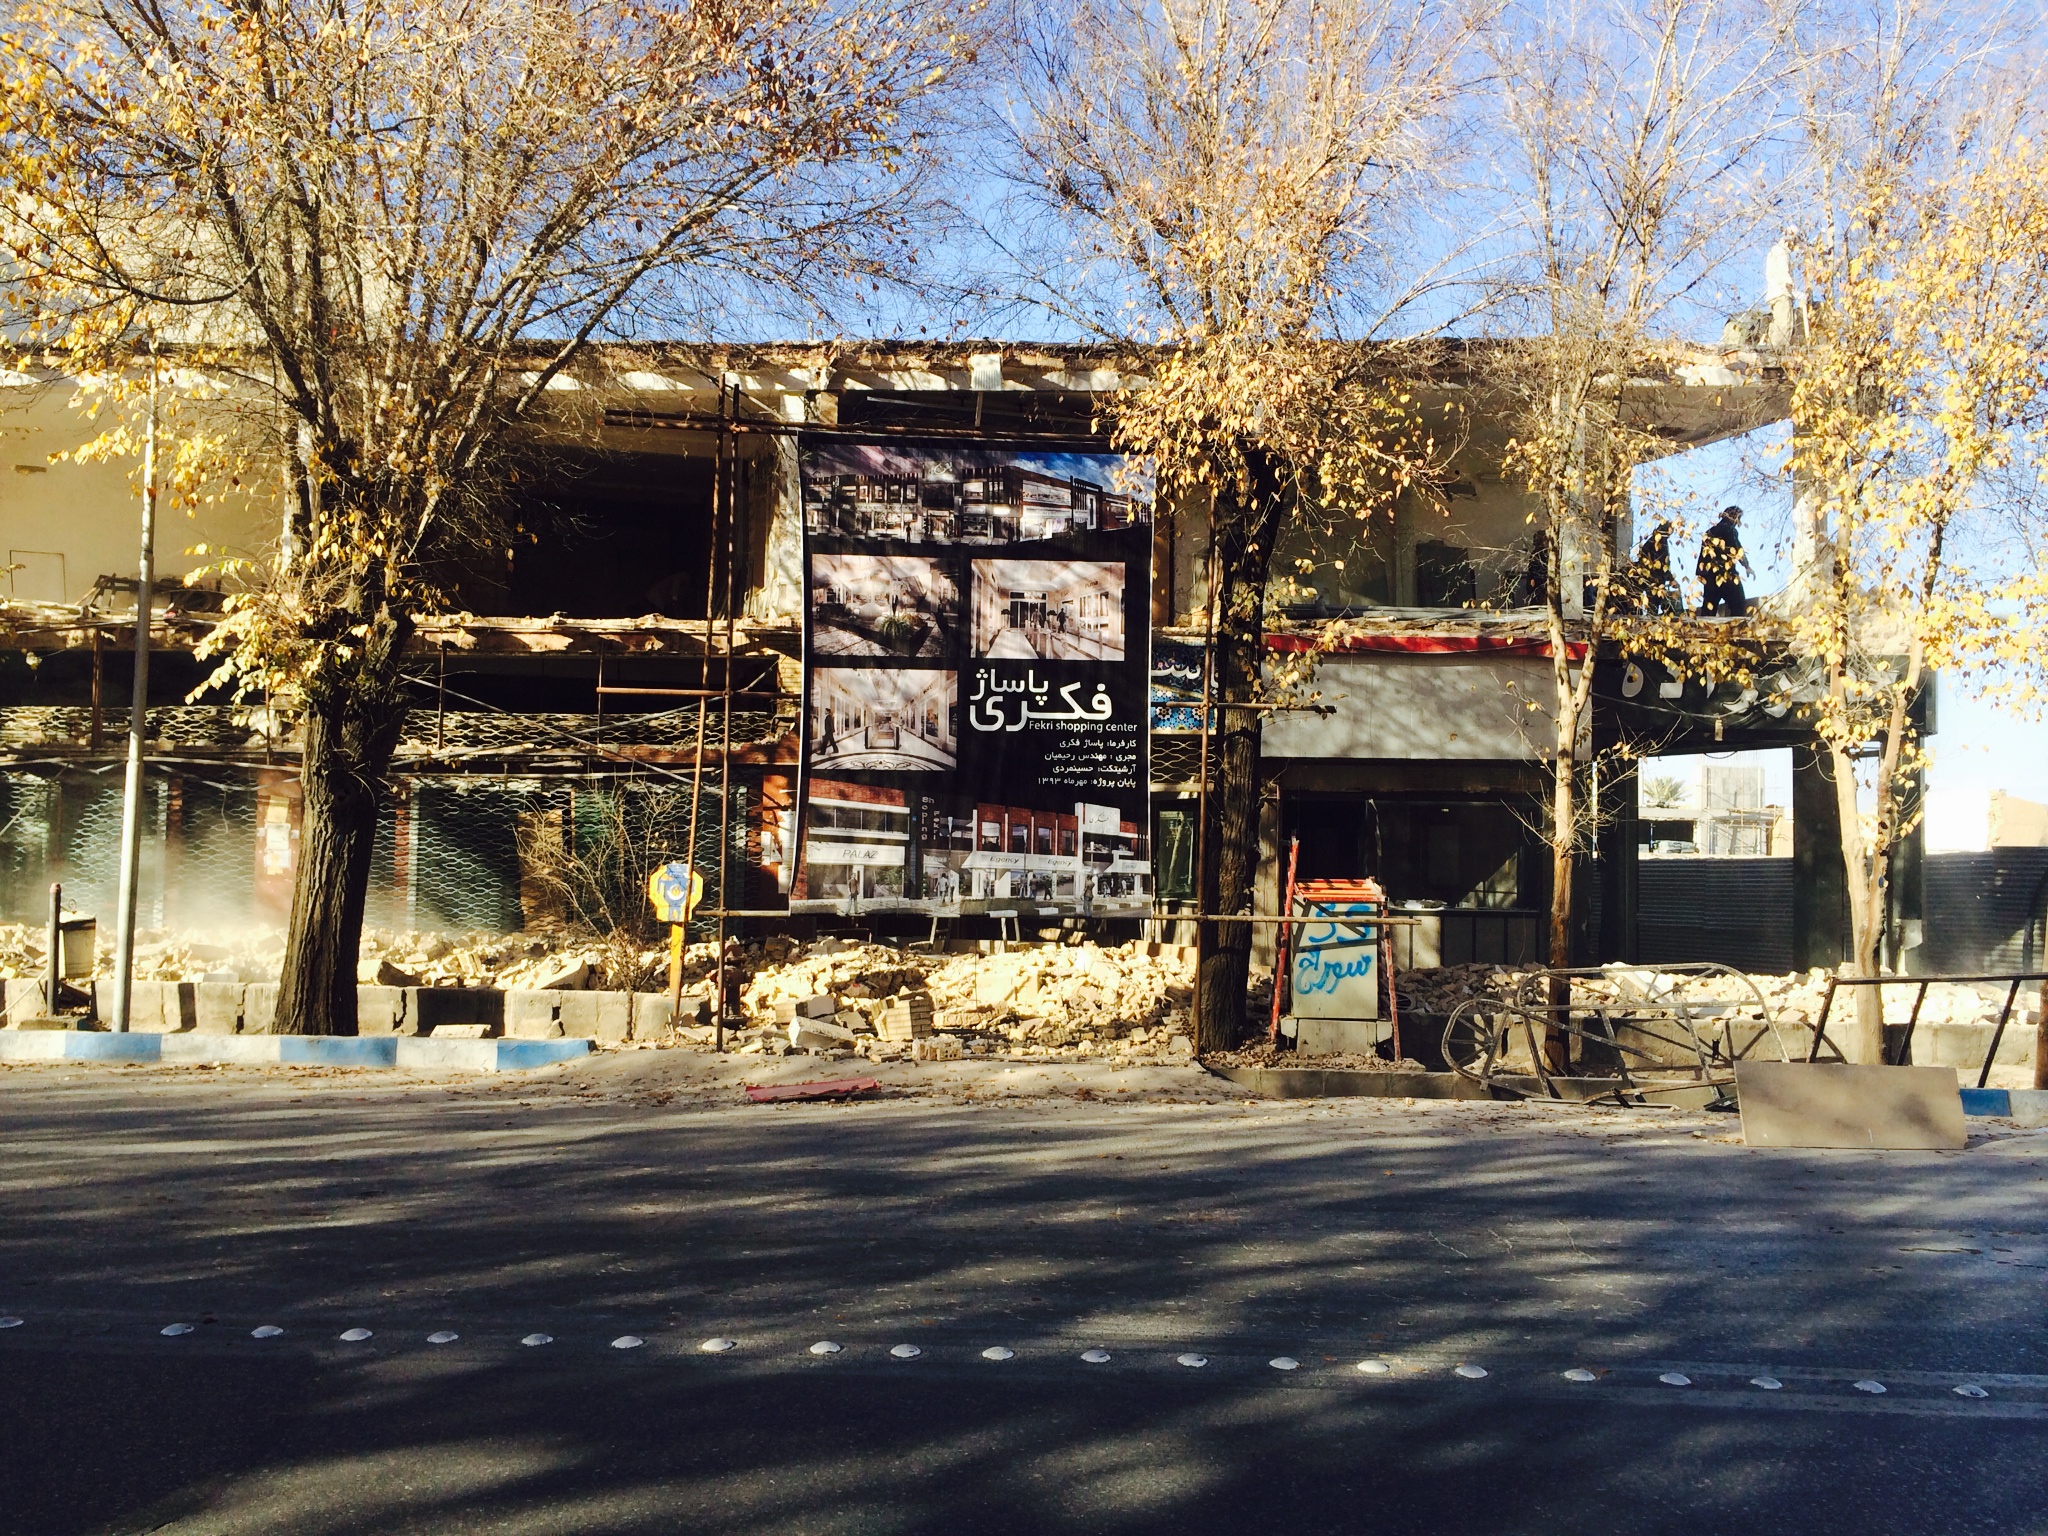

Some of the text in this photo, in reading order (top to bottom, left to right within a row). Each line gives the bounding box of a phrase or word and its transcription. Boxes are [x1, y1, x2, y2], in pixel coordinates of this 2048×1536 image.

[969, 668, 1049, 706] پاساژ
[969, 681, 1113, 732] فکری
[1029, 720, 1138, 733] Fekri shopping center
[1059, 738, 1137, 749] کارفرما: پاساژ فکری
[1044, 752, 1076, 761] رحیمیان
[1078, 753, 1107, 762] مهندس
[1115, 754, 1137, 762] مجری
[1038, 777, 1062, 785] ۱۳۹۳
[1063, 777, 1088, 787] مهرماه
[1117, 778, 1137, 788] پایان
